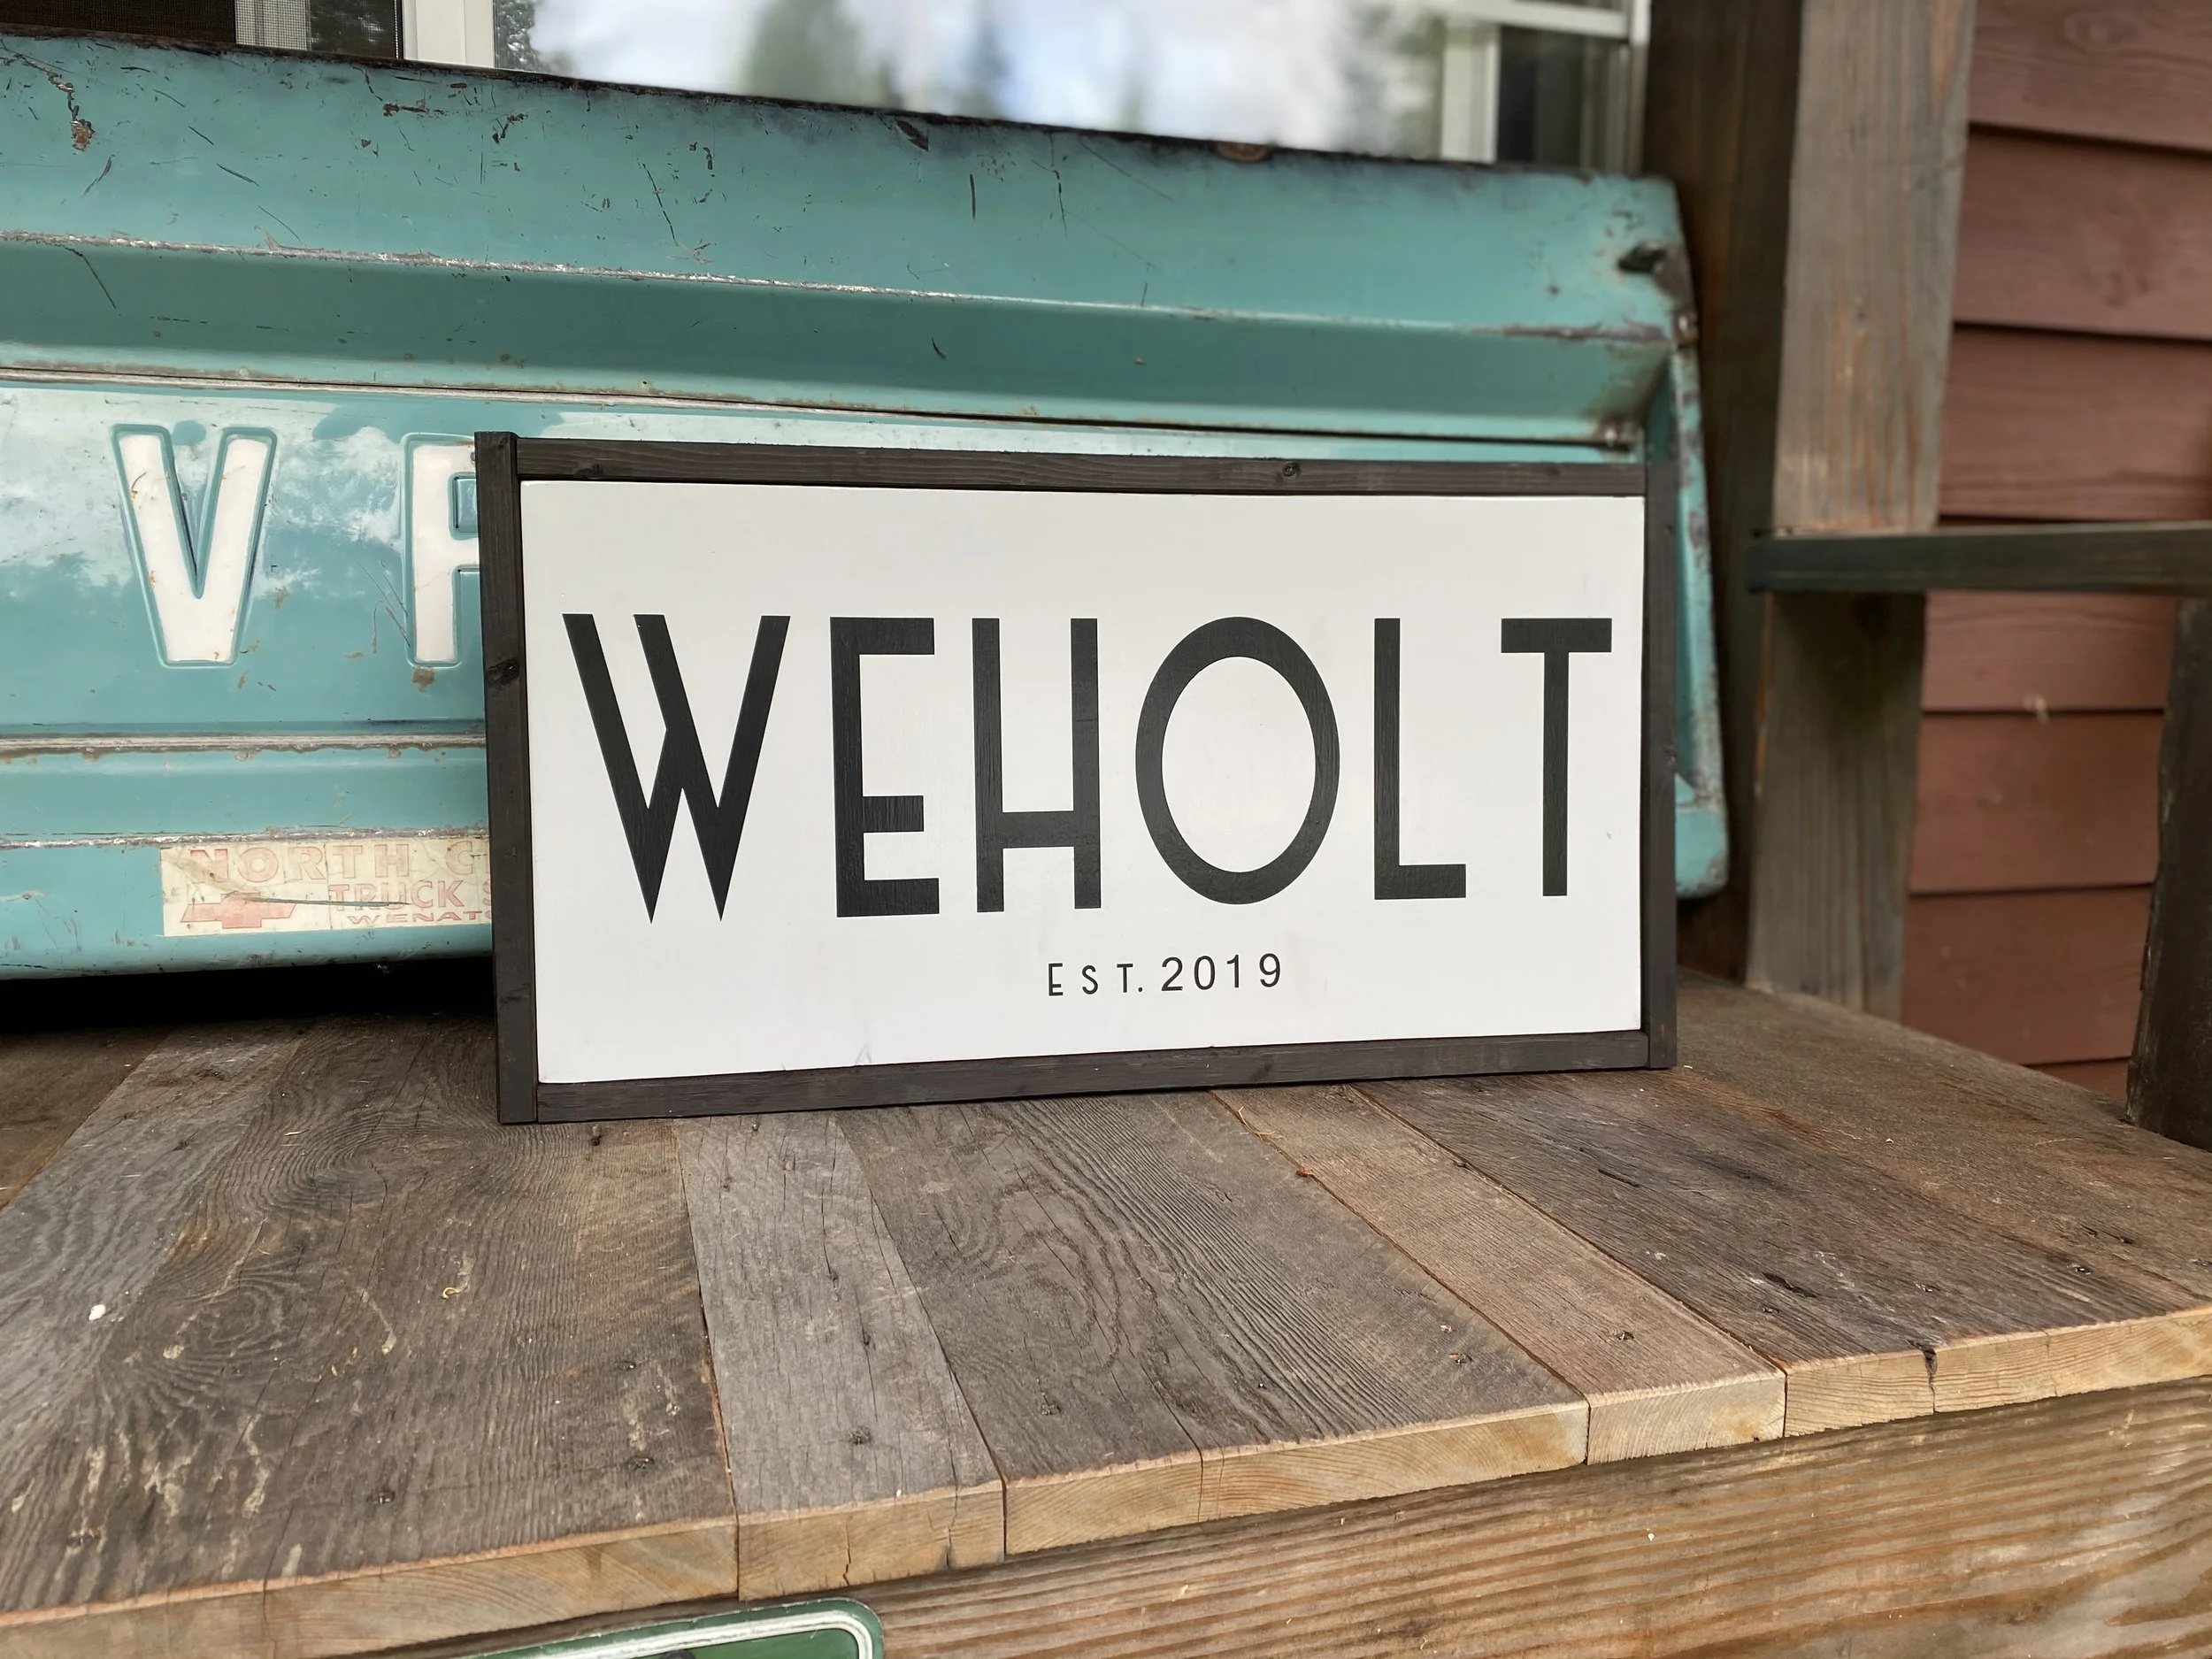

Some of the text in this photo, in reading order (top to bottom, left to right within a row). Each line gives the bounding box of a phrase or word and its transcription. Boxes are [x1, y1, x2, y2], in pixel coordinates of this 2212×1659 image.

[562, 613, 1612, 924] WEHOLT
[189, 842, 411, 883] NORTH
[328, 879, 465, 912] TRUCK
[1048, 953, 1280, 996] EST. 2019
